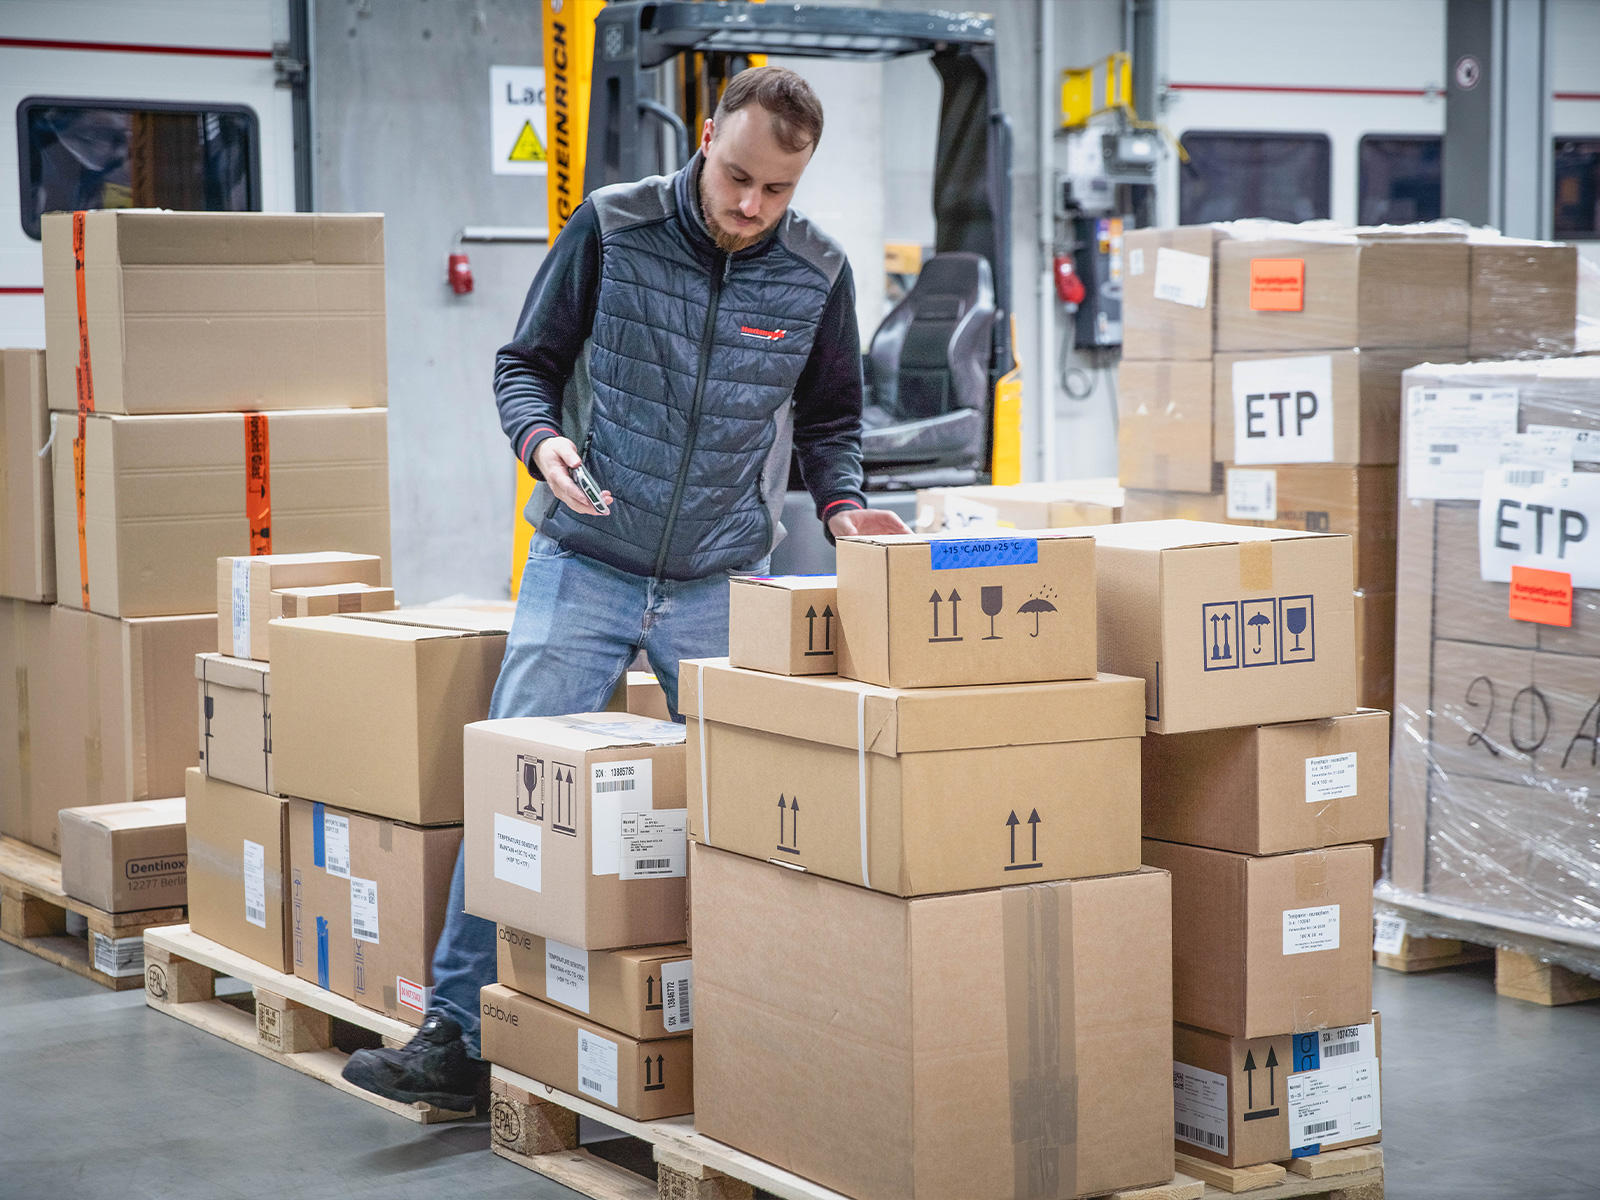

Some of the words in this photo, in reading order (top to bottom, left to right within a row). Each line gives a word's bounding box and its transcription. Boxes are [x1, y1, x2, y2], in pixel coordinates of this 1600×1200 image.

[1246, 391, 1318, 438] ETP
[1495, 498, 1589, 559] ETP
[943, 546, 958, 554] +15
[971, 543, 991, 553] AND
[993, 542, 1009, 551] +25
[131, 860, 185, 874] Dentinox
[498, 928, 532, 951] abbvie
[482, 1003, 519, 1027] abbvie
[494, 1107, 517, 1136] EPAL
